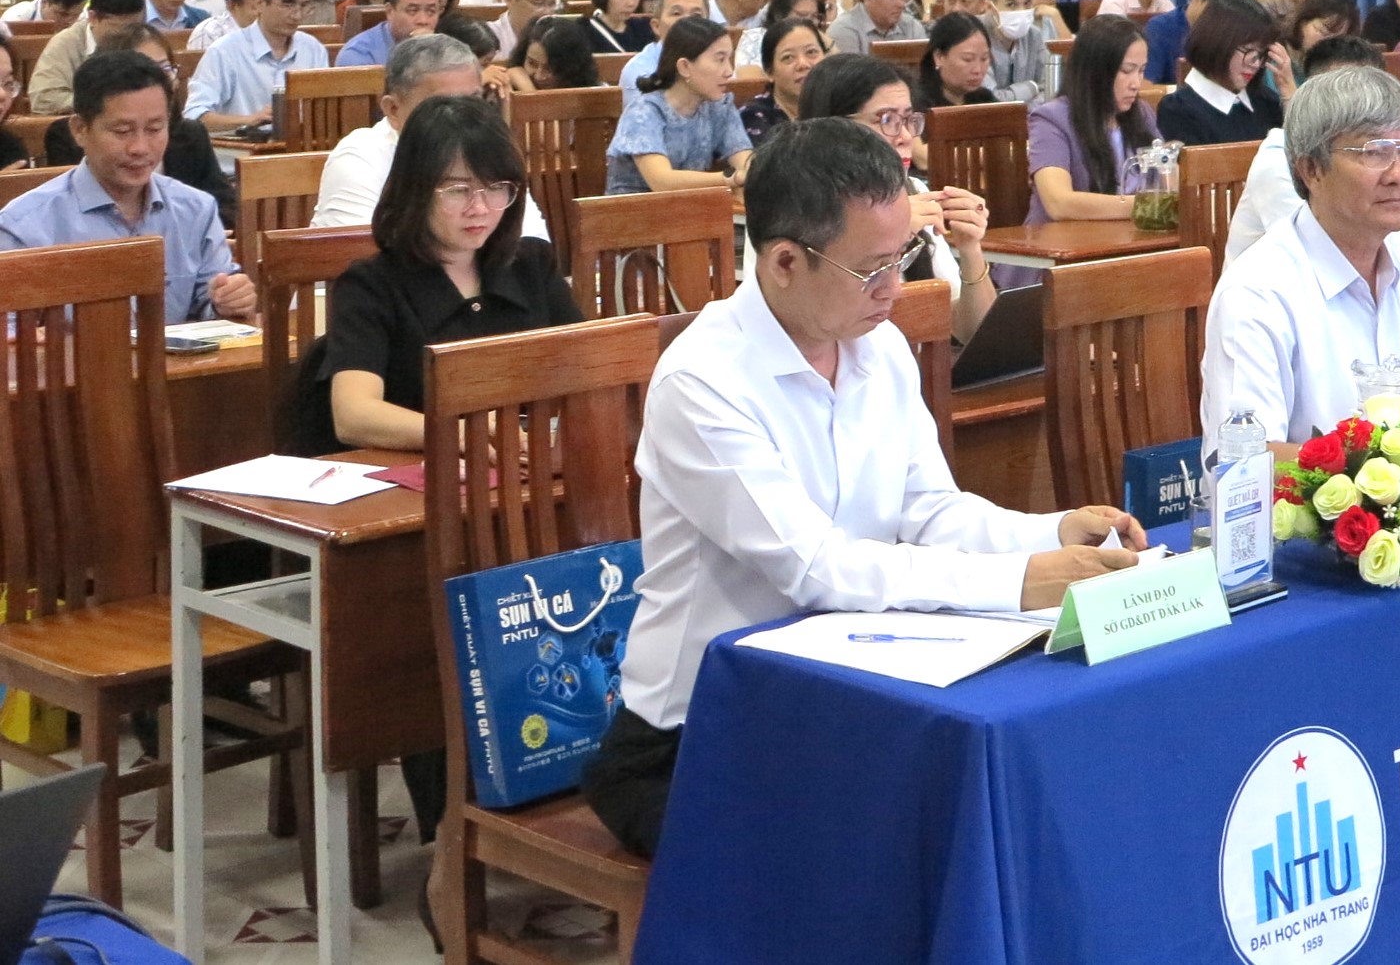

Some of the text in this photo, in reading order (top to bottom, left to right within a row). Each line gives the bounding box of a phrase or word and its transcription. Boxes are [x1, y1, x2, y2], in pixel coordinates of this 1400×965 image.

[1160, 482, 1181, 503] SỤN
[1159, 502, 1186, 515] FNTU
[1123, 585, 1176, 609] LÃNH ĐẠO
[499, 602, 531, 629] SỤN
[552, 589, 574, 616] CÁ
[502, 626, 539, 645] FNTU
[470, 668, 483, 697] SỤN
[475, 699, 486, 715] VI
[1263, 842, 1353, 922] NTU
[1250, 897, 1370, 952] ĐẠI HỌC NHA TRANG
[1302, 935, 1324, 954] 1959
